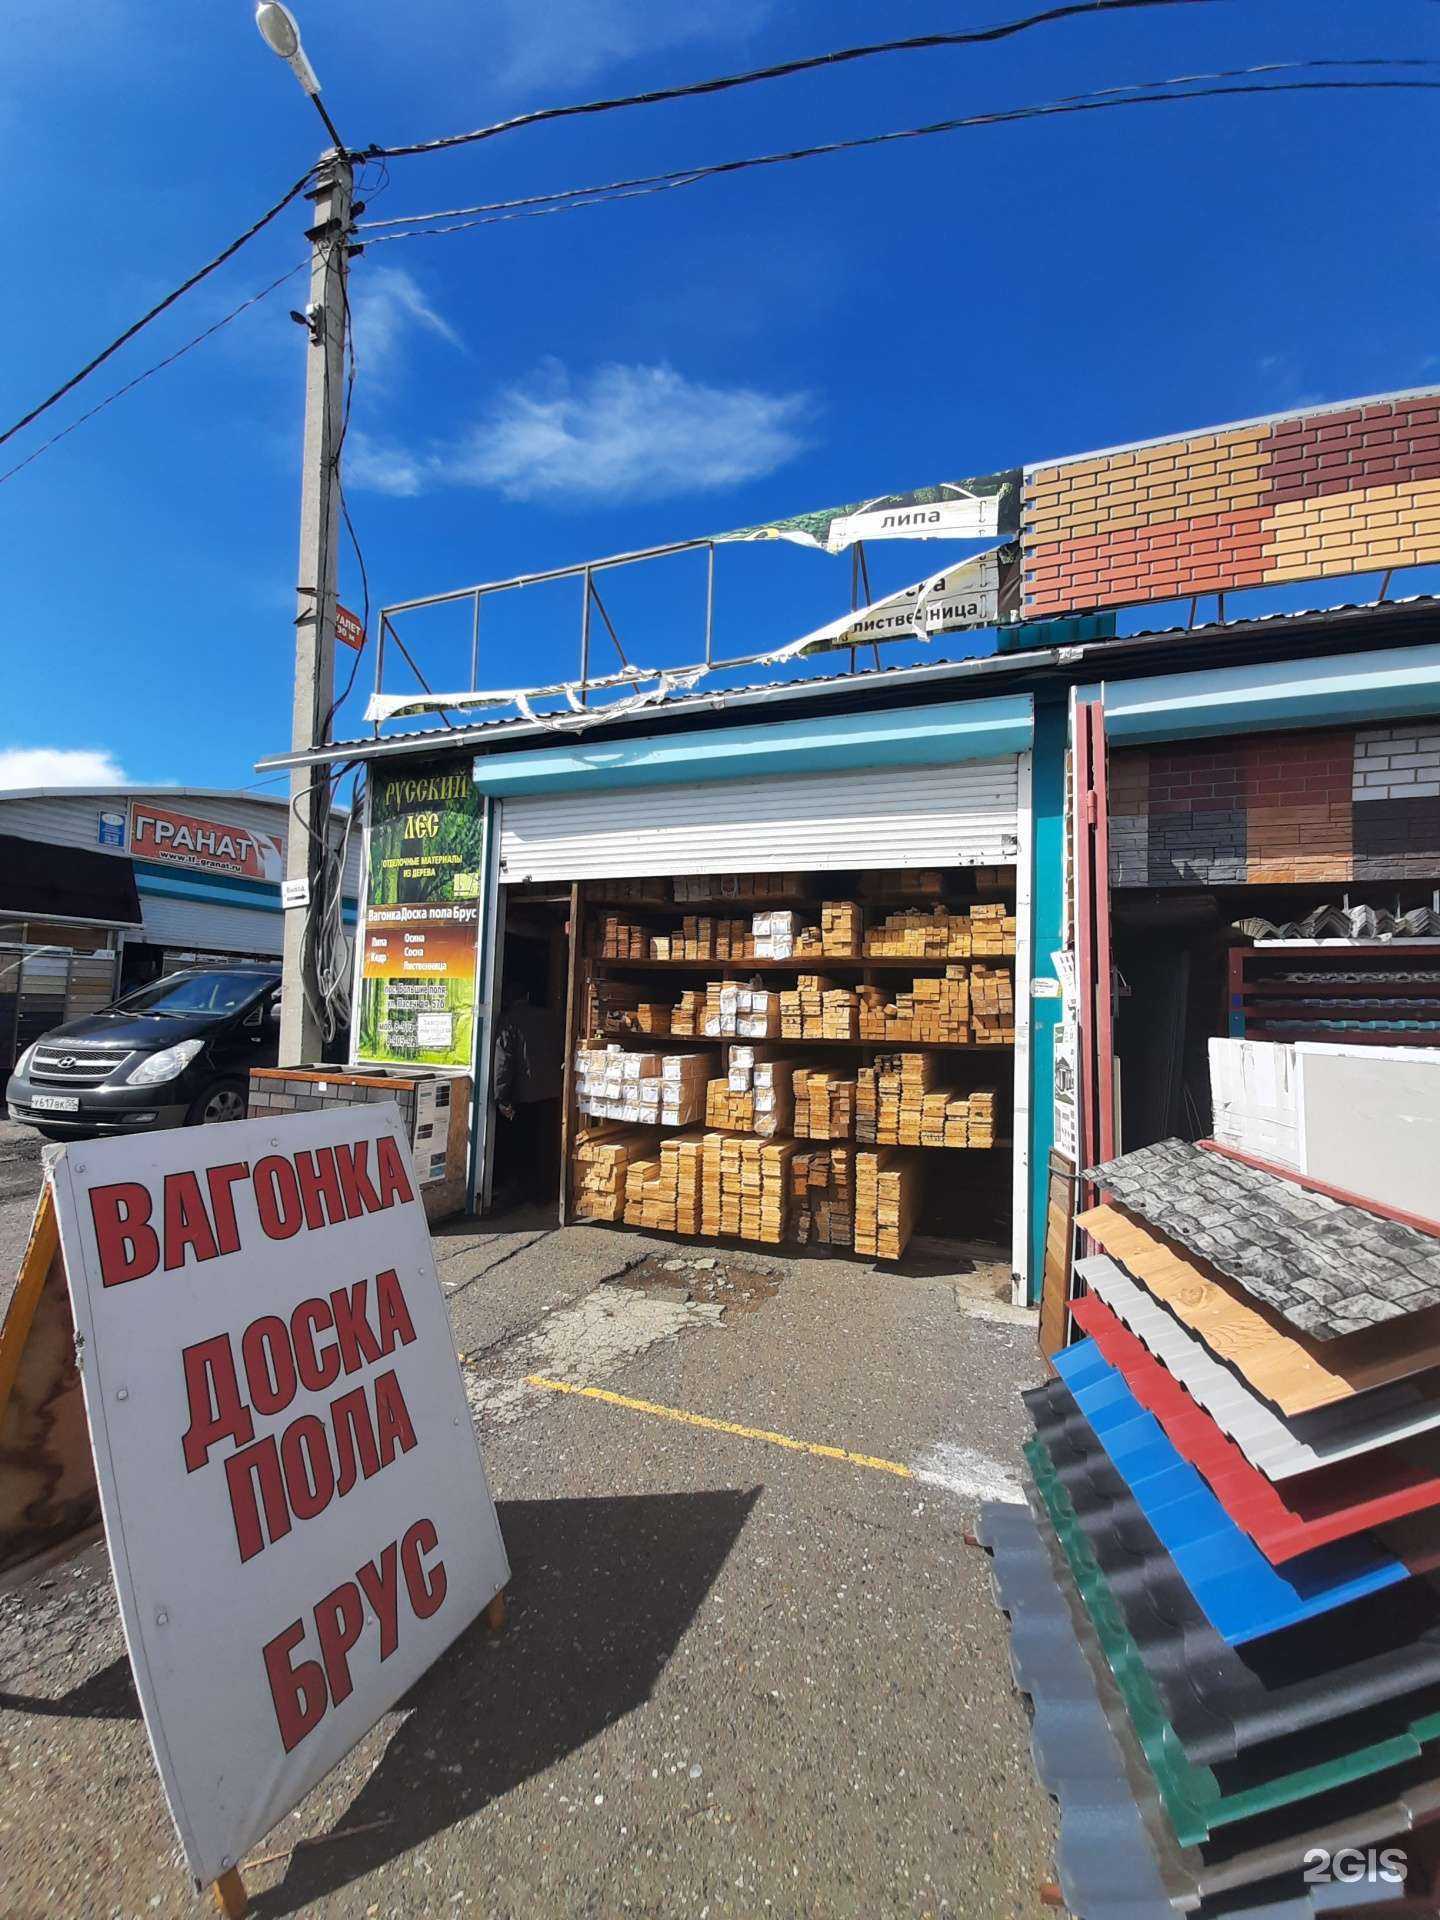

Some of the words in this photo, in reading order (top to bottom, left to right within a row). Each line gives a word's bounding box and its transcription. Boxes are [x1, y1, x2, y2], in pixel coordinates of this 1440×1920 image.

[881, 510, 940, 528] липа
[853, 602, 978, 632] лиственица
[384, 769, 468, 811] РУССКИЙ
[136, 815, 253, 861] ГРАНАТ
[404, 812, 439, 839] ЛЕС
[382, 857, 420, 868] ОТДЕЛОЧНЫЕ
[420, 854, 463, 866] МАТЕРИАЛЫ
[403, 869, 411, 878] ИЗ
[412, 868, 436, 879] ДЕРЕВА
[368, 909, 401, 921] Вагонка
[401, 907, 427, 921] Доска
[429, 908, 452, 919] пола
[453, 906, 477, 922] Брус
[404, 933, 425, 943] Осина
[404, 947, 424, 957] Сосна
[88, 1136, 414, 1288] ВАГОНКА
[182, 1268, 418, 1473] ДОСКА
[224, 1369, 418, 1564] ПОЛА
[262, 1518, 447, 1754] БРУС
